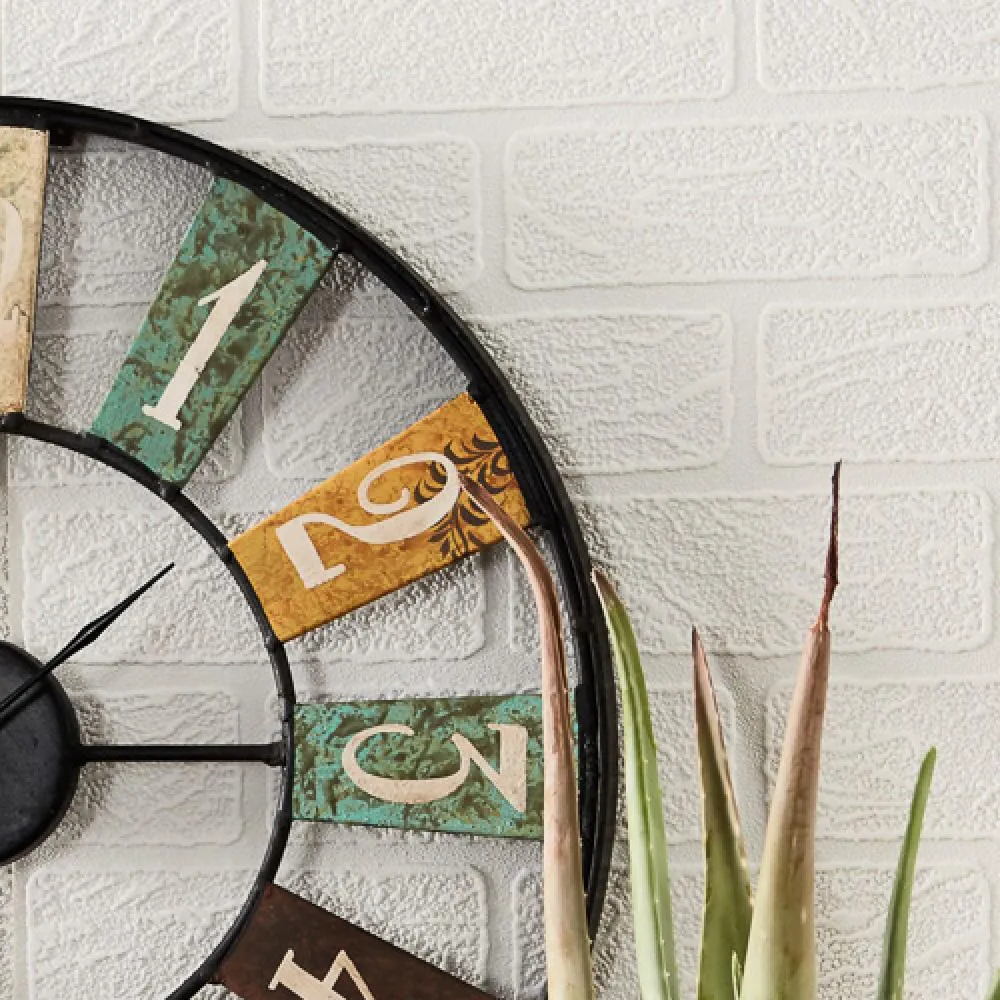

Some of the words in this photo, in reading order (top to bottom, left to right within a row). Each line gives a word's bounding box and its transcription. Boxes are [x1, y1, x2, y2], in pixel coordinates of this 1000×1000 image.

[143, 258, 267, 432] 1
[275, 451, 463, 591] 2
[341, 723, 527, 815] 3
